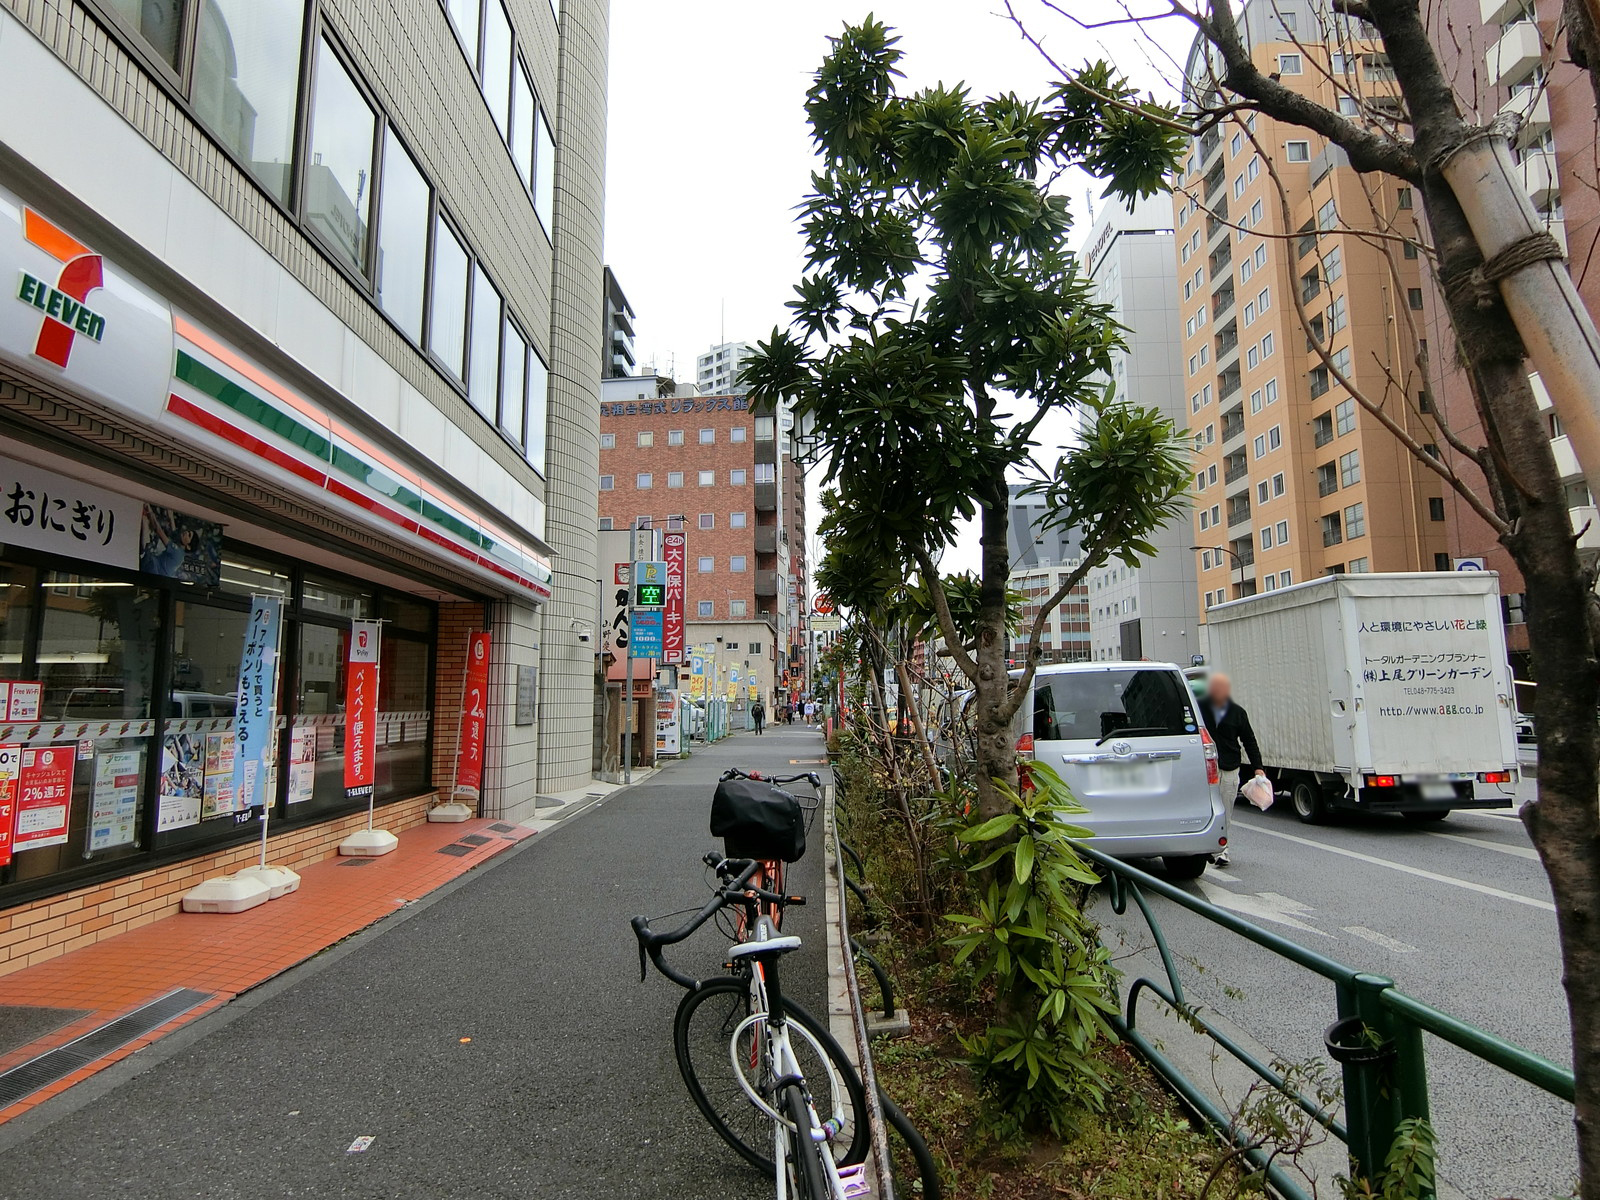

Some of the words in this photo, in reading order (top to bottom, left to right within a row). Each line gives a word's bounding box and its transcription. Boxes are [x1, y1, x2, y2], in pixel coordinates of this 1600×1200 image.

[5, 482, 114, 546] おにぎり
[667, 536, 684, 545] 24h
[641, 586, 660, 604] 空
[666, 548, 683, 648] 大久保パーキング
[1359, 619, 1487, 633] 人と環境にやさしい花と緑
[693, 657, 702, 673] P
[1365, 653, 1486, 665] トータルガーデニングプランナー
[254, 629, 267, 717] アプリで買うと
[13, 687, 25, 695] Free
[353, 669, 365, 781] ペイペイ使えます。
[25, 769, 67, 778] キャッシュレスで
[23, 785, 66, 802] 2%還元
